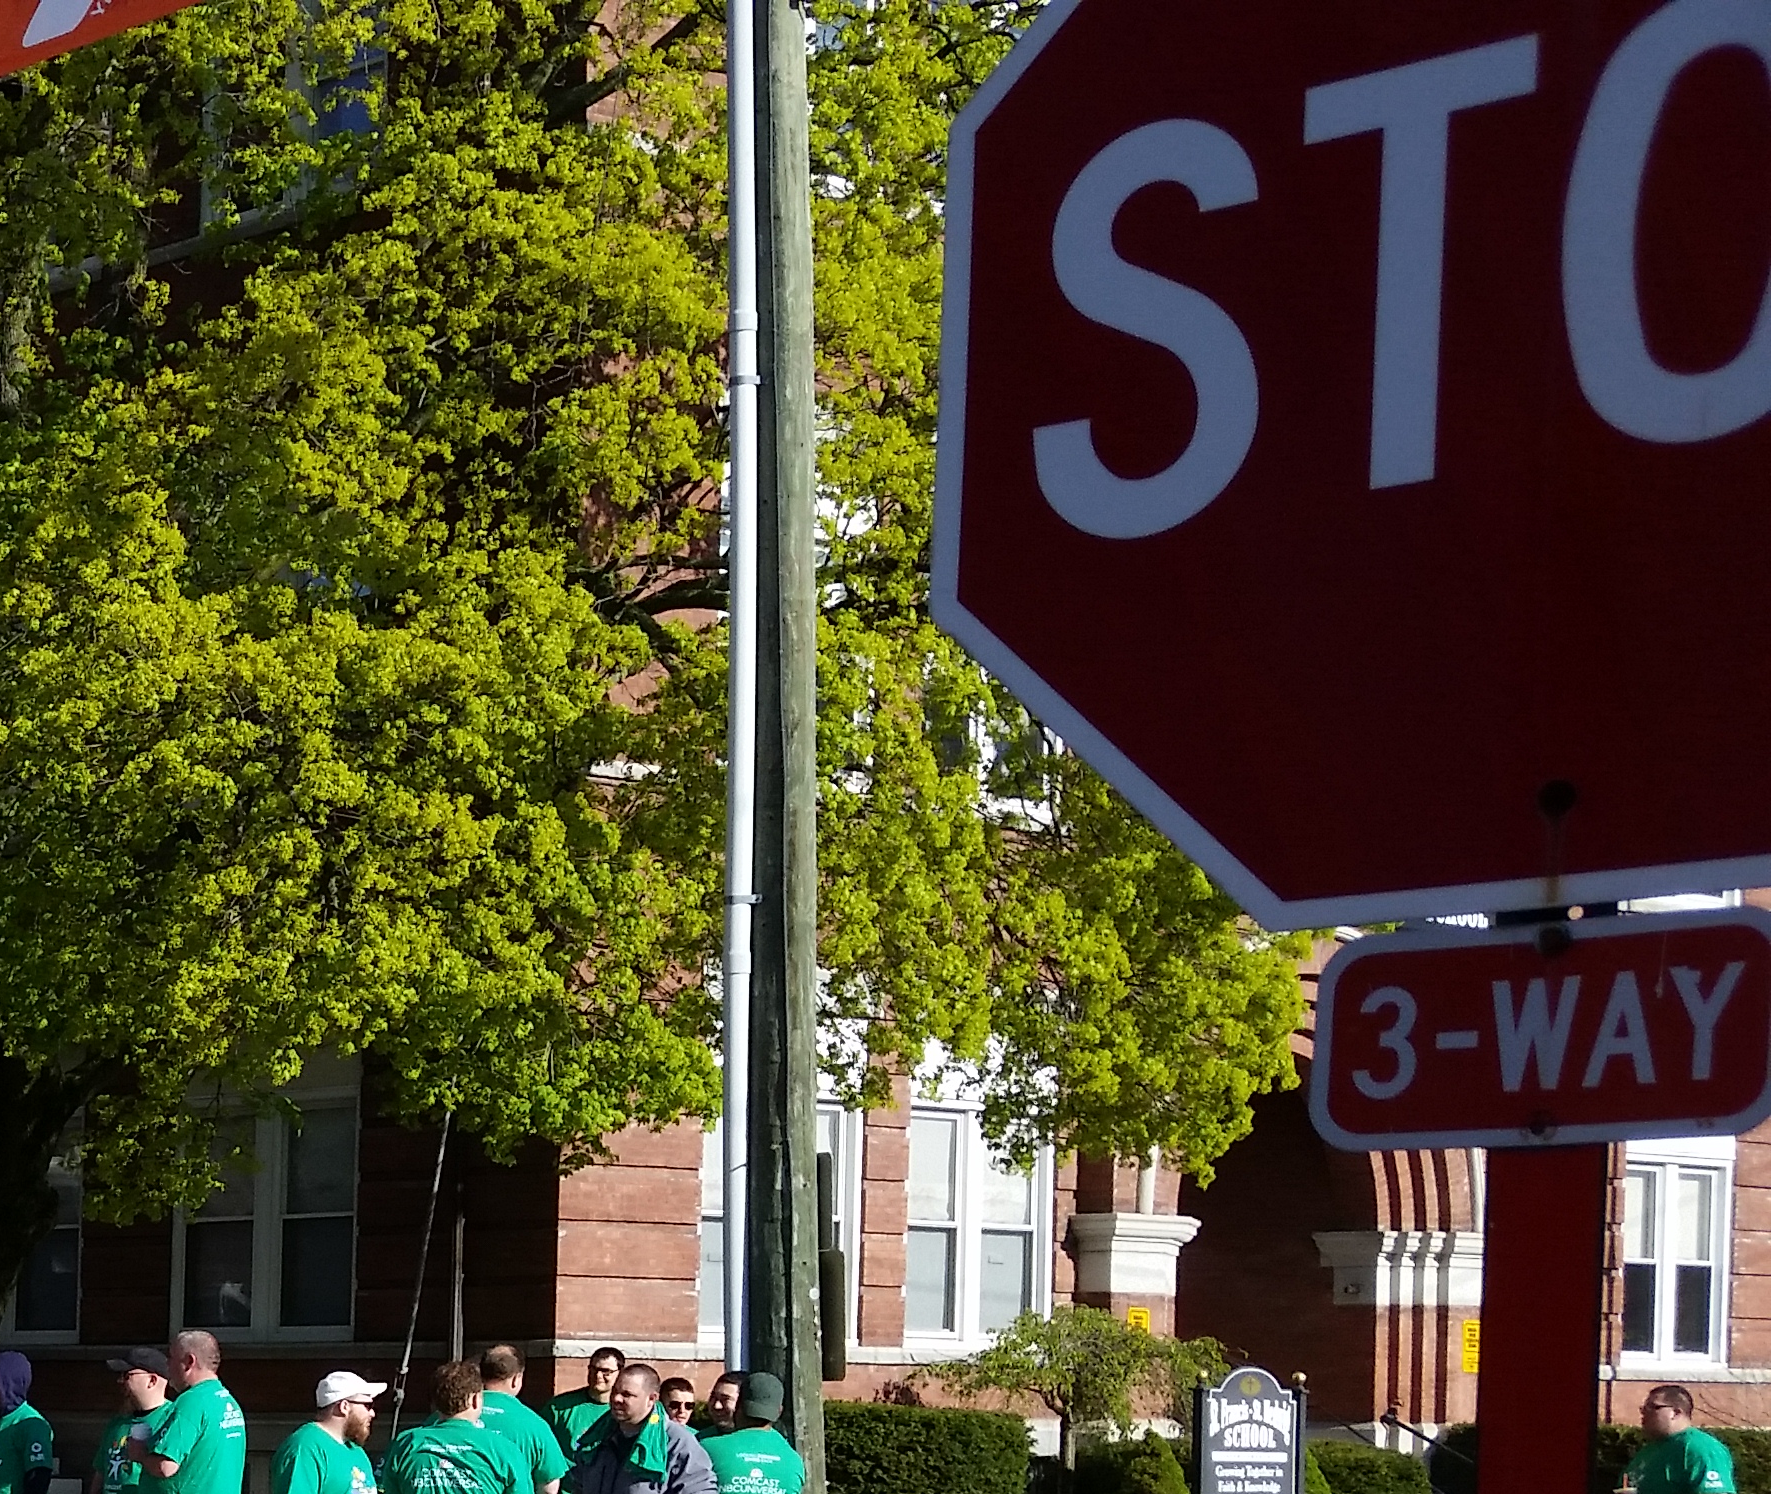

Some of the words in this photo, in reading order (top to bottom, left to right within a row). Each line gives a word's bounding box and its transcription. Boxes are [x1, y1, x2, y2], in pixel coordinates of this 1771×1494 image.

[1033, 0, 1771, 540] STO
[1351, 961, 1745, 1100] 3-WAY
[1223, 1423, 1277, 1448] SCHOOL
[731, 1476, 780, 1487] COMCAST
